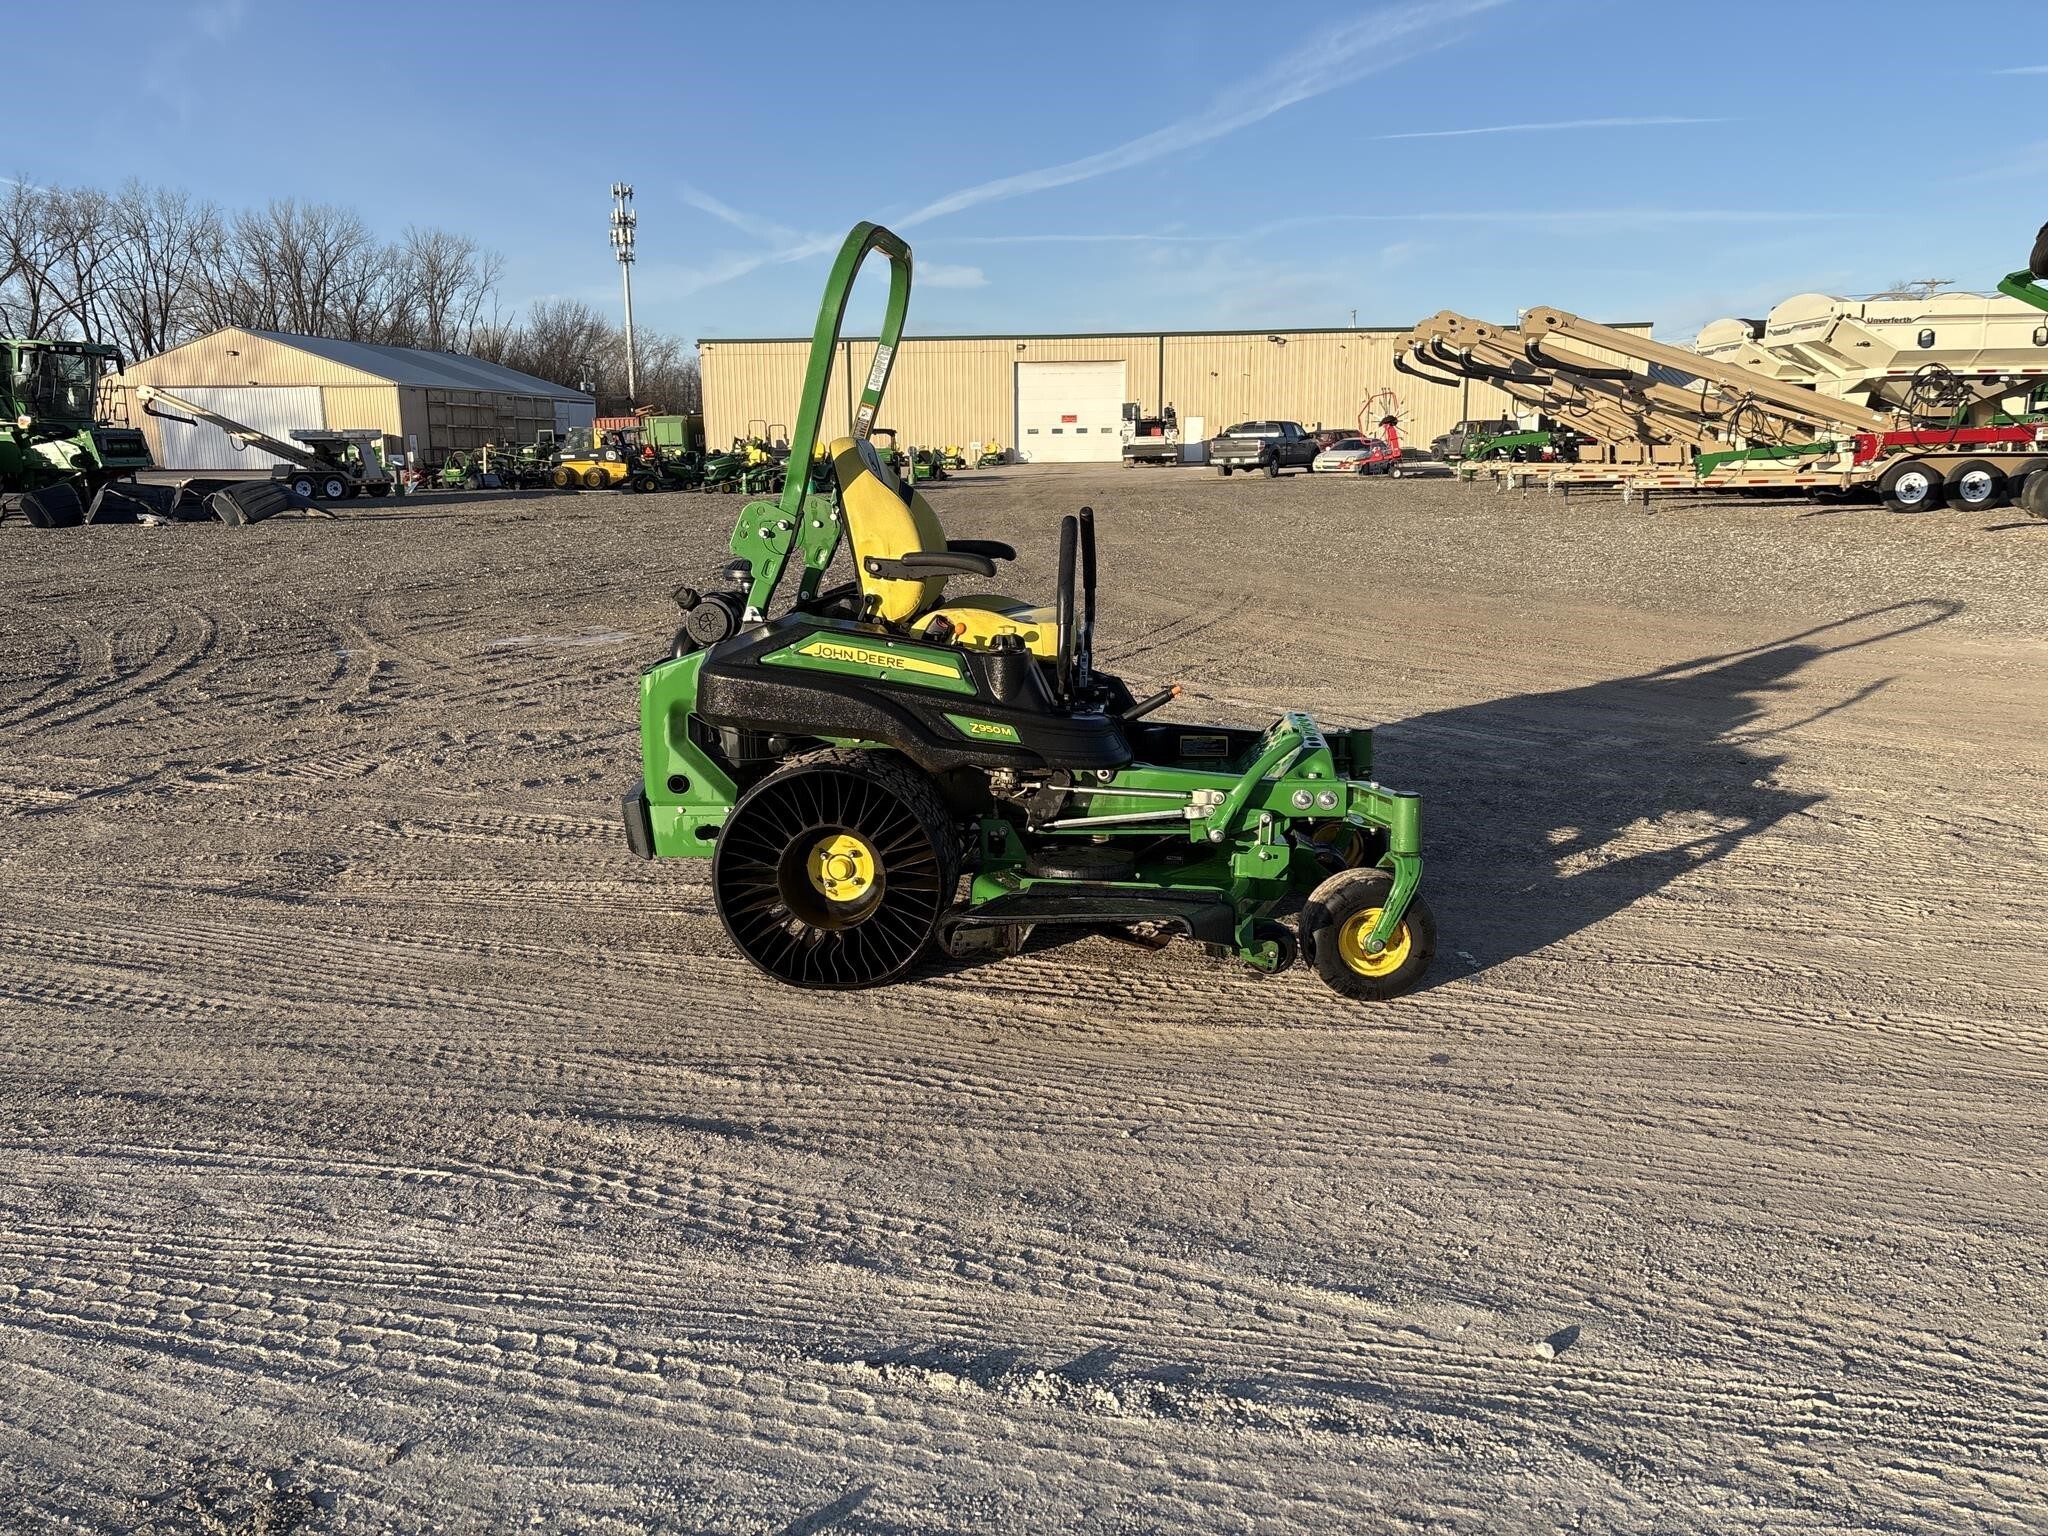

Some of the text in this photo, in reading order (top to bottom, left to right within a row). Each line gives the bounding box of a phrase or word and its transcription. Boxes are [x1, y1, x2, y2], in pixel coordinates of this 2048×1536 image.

[814, 644, 905, 668] JOHN DEERE
[969, 722, 1012, 736] Z950M
